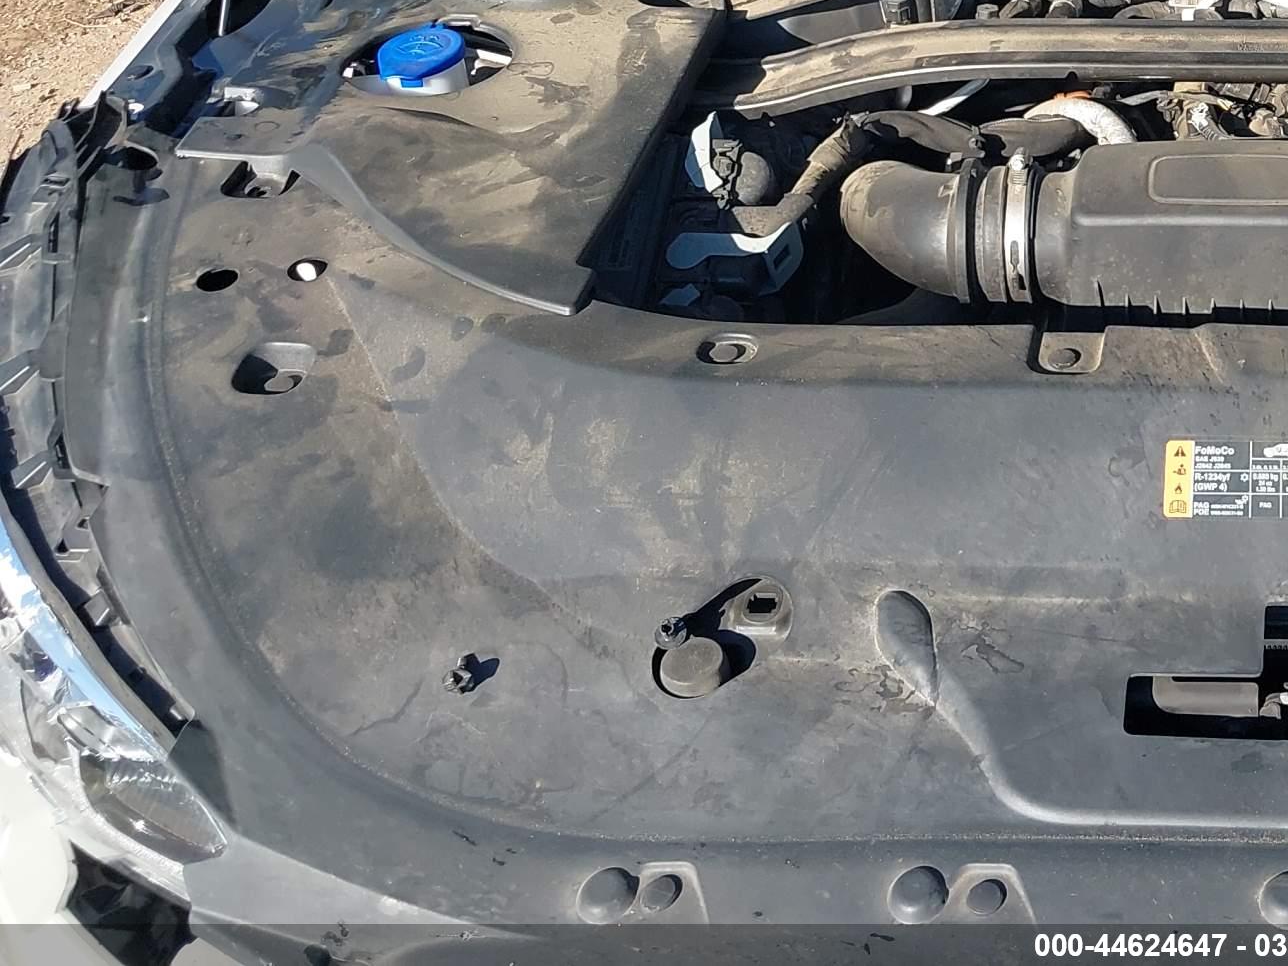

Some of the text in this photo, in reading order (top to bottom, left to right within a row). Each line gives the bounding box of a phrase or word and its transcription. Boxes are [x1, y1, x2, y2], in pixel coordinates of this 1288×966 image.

[1195, 446, 1234, 455] FoMoCo
[1195, 473, 1230, 482] R-1234yf
[1270, 473, 1278, 482] kg
[1194, 482, 1227, 492] (GWP 4)
